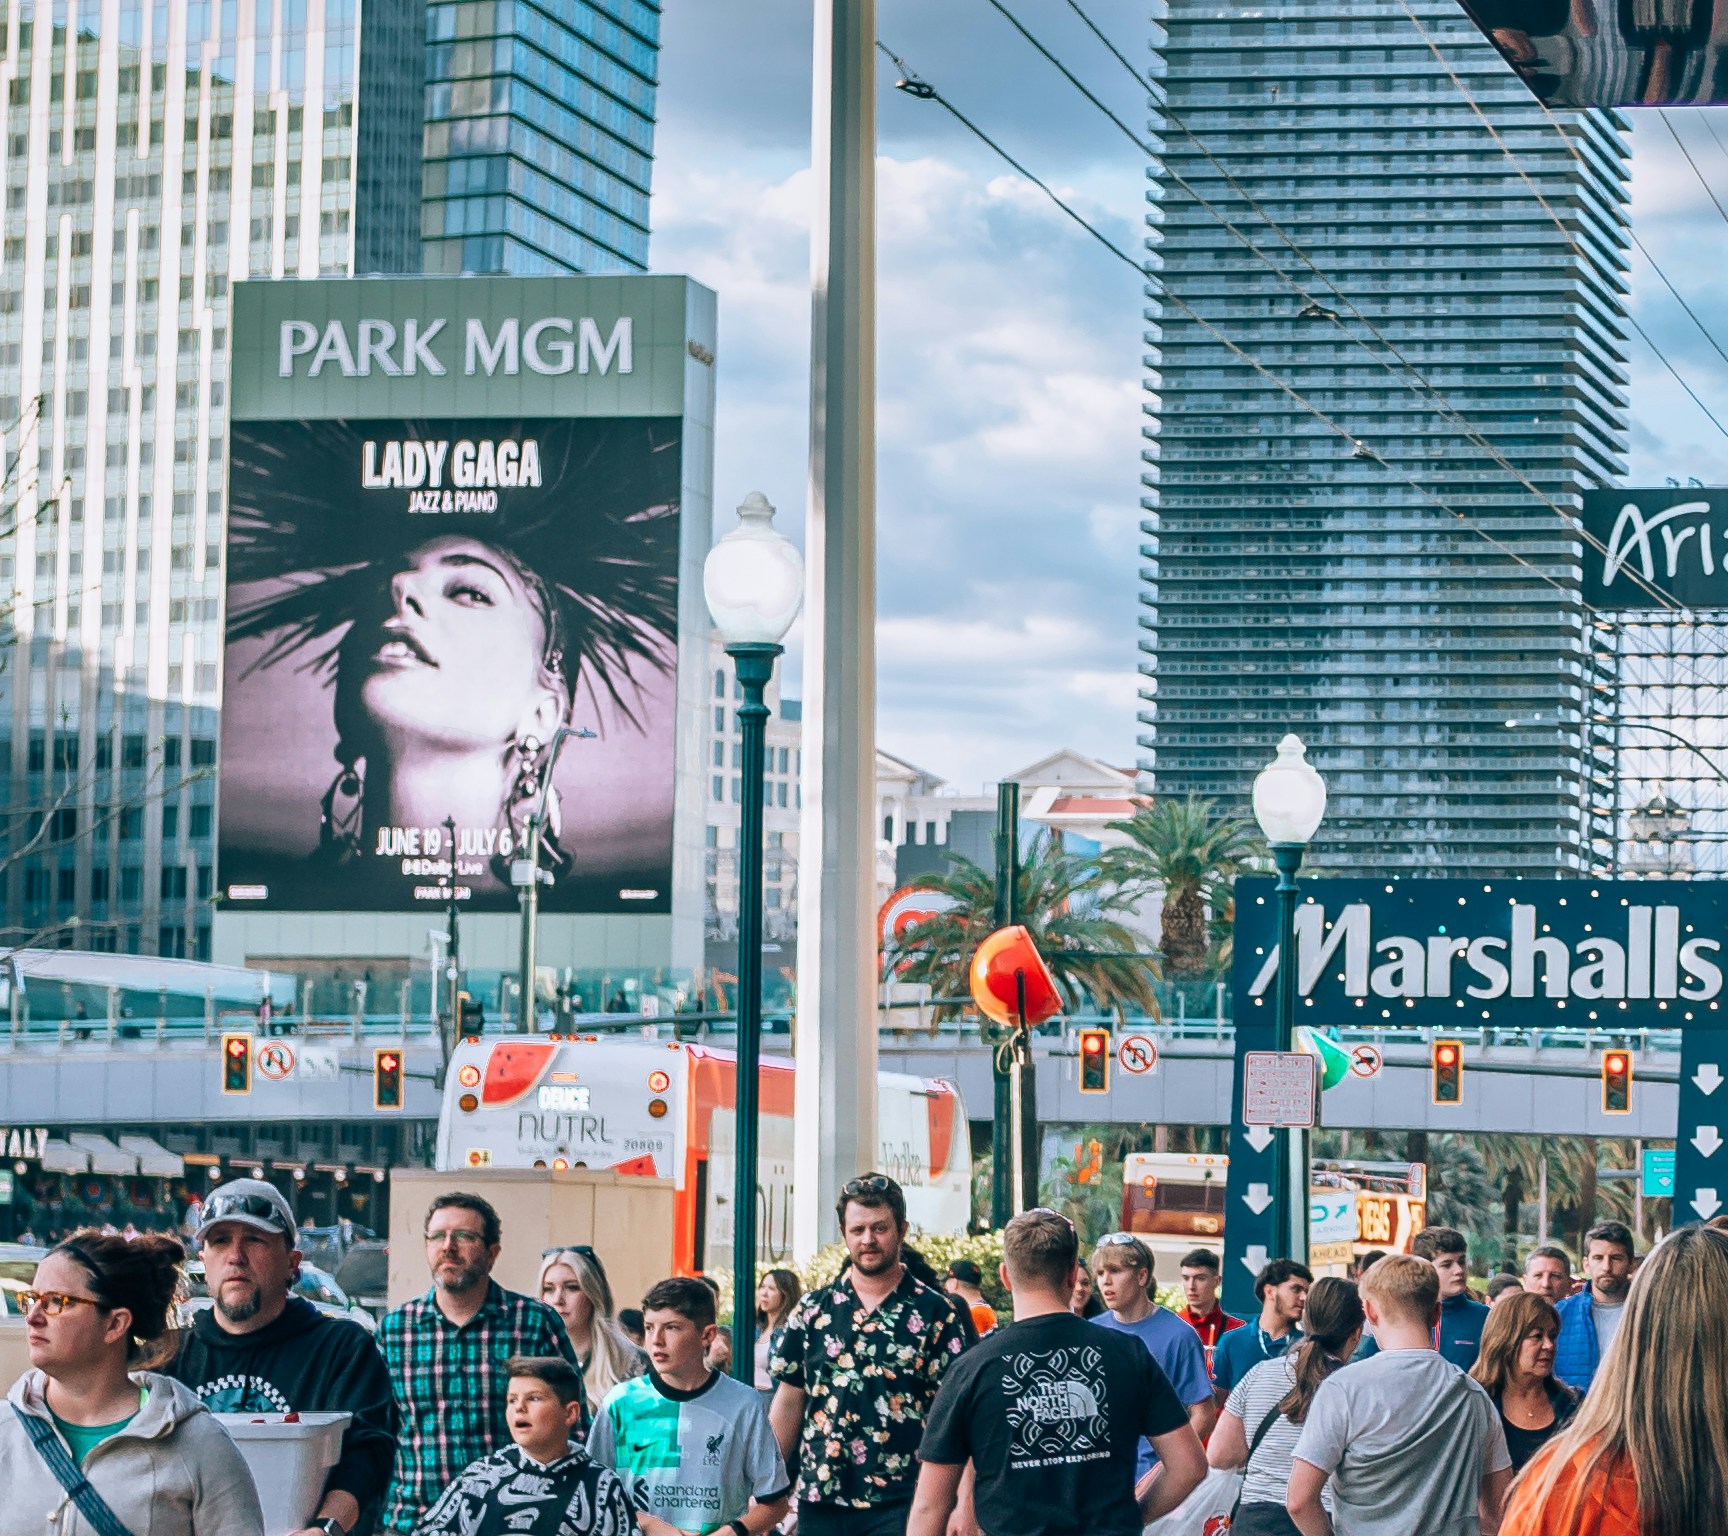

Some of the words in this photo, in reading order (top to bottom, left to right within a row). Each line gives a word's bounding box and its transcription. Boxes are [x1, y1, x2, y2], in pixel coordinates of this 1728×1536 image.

[279, 318, 448, 377] PARK
[464, 317, 634, 376] MGM
[362, 440, 449, 489] LADY
[453, 439, 542, 488] GAGA
[408, 490, 441, 513] JAZZ
[442, 490, 453, 513] &
[454, 490, 498, 513] PIANO
[375, 826, 421, 856] JUNE
[422, 826, 442, 856] 19
[458, 827, 498, 856] JULY
[499, 828, 514, 857] 6
[1248, 902, 1724, 1001] Marshalls
[1312, 1246, 1348, 1259] AHEAD
[1037, 1381, 1068, 1395] THE
[1016, 1394, 1069, 1412] NORTH
[1033, 1406, 1071, 1422] FACE
[1011, 1458, 1041, 1470] NEVER
[1043, 1456, 1065, 1466] STOP
[1065, 1450, 1111, 1463] EXPLORING
[654, 1484, 718, 1498] standard
[654, 1496, 721, 1510] chartered
